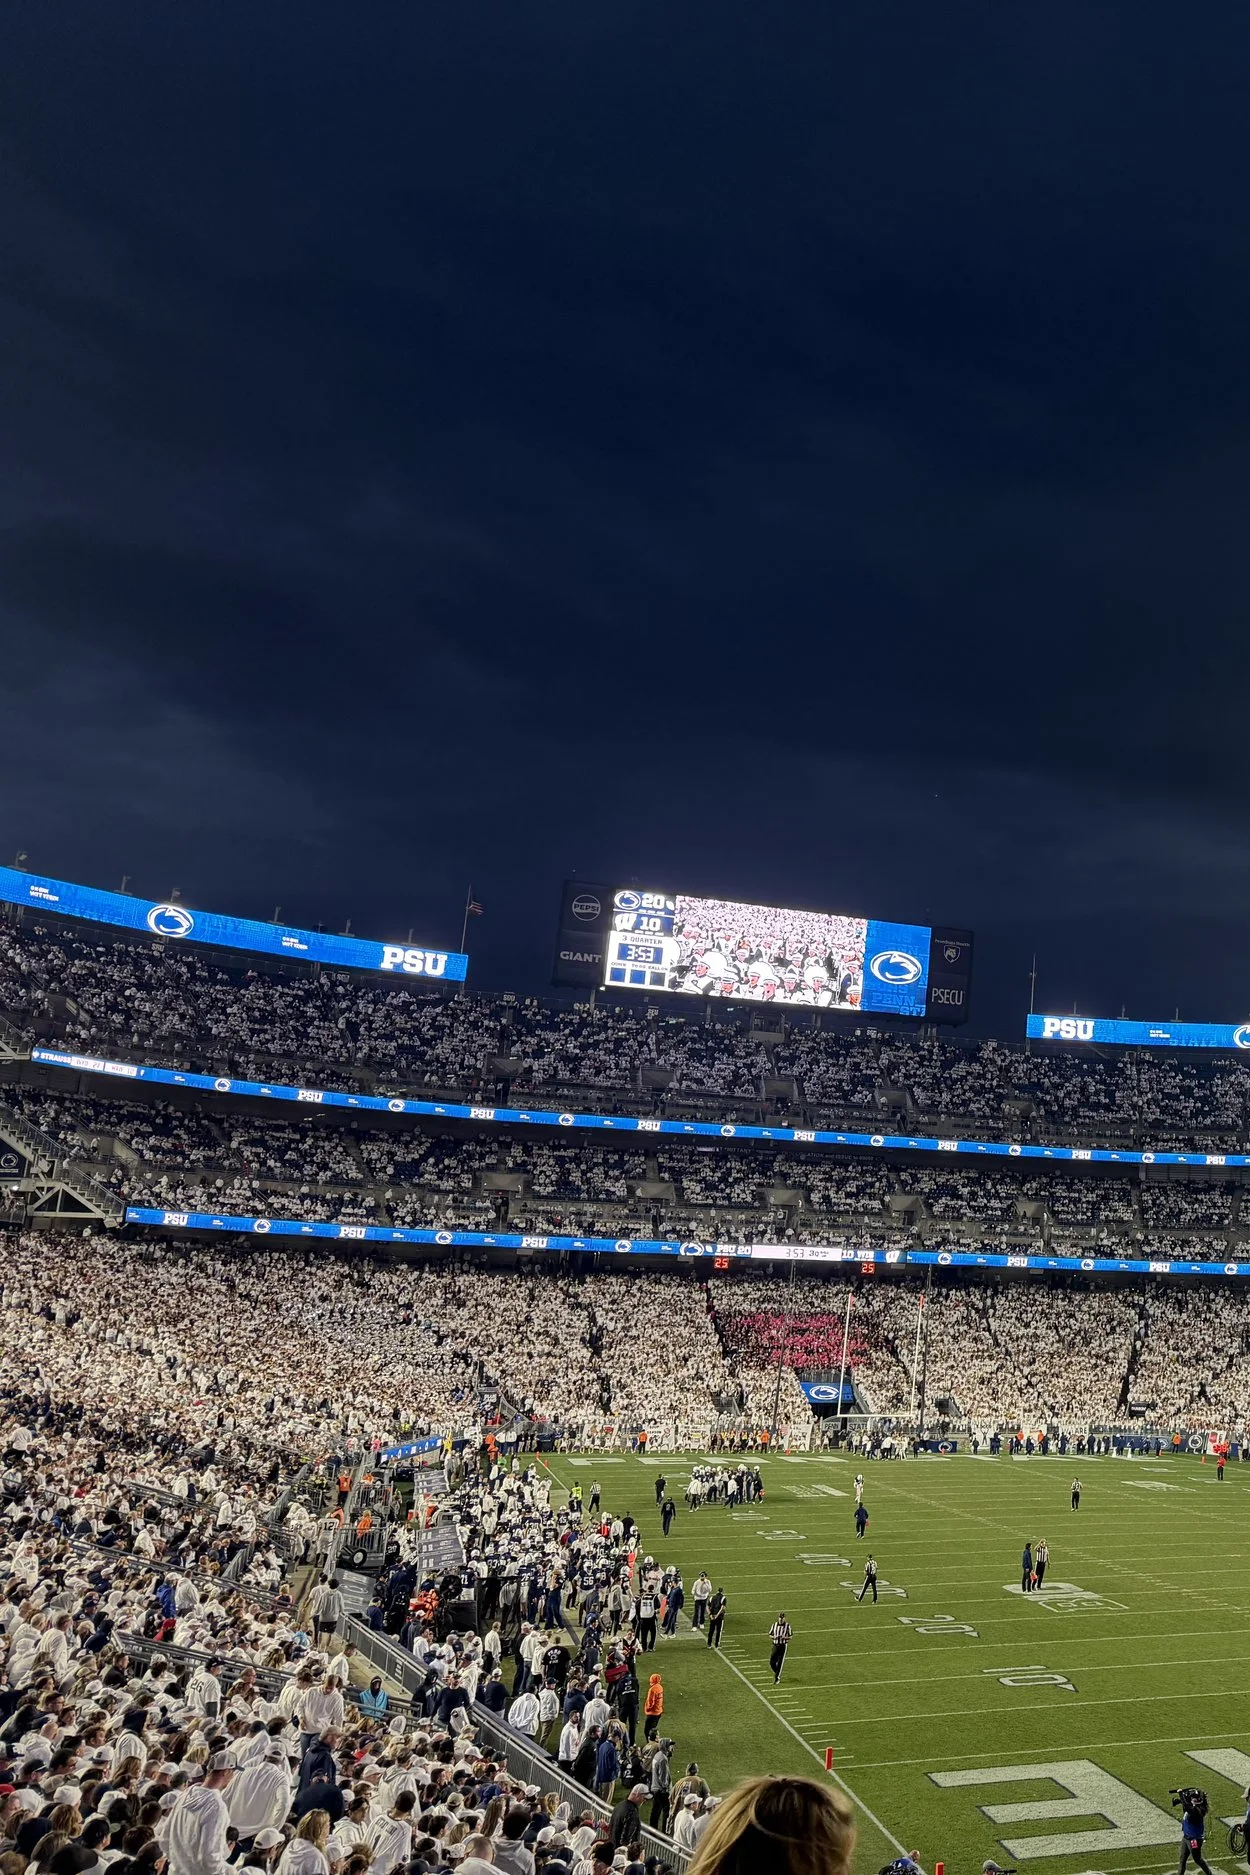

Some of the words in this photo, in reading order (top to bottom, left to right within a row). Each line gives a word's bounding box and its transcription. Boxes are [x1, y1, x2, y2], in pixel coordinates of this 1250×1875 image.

[574, 903, 599, 912] PEPSI
[642, 894, 665, 909] 20
[641, 917, 661, 931] 10
[631, 936, 663, 945] QUARTER
[560, 951, 601, 962] GIANT
[627, 945, 654, 962] 3:53
[381, 947, 446, 976] PSU
[932, 988, 963, 1005] PSECU
[1043, 1018, 1094, 1039] PSU
[297, 1089, 323, 1102] PSU
[470, 1108, 495, 1120] PSU
[638, 1119, 660, 1131] PSU
[794, 1130, 815, 1142] PSU
[938, 1140, 958, 1151] PSU
[1071, 1149, 1092, 1160] PSU
[1206, 1155, 1225, 1166] PSU
[164, 1212, 188, 1226] PSU
[339, 1226, 366, 1239] PSU
[522, 1237, 547, 1248] PSU
[716, 1244, 736, 1254] PSU
[737, 1245, 751, 1254] 20
[842, 1250, 853, 1259] 10
[714, 1257, 729, 1269] 25
[861, 1262, 874, 1273] 25
[1007, 1256, 1028, 1268] PSU
[1150, 1261, 1170, 1273] PSU
[824, 1422, 840, 1430] PENN
[323, 1522, 334, 1531] 12
[584, 1576, 595, 1586] 56
[896, 1614, 981, 1639] 20
[981, 1665, 1080, 1694] 10
